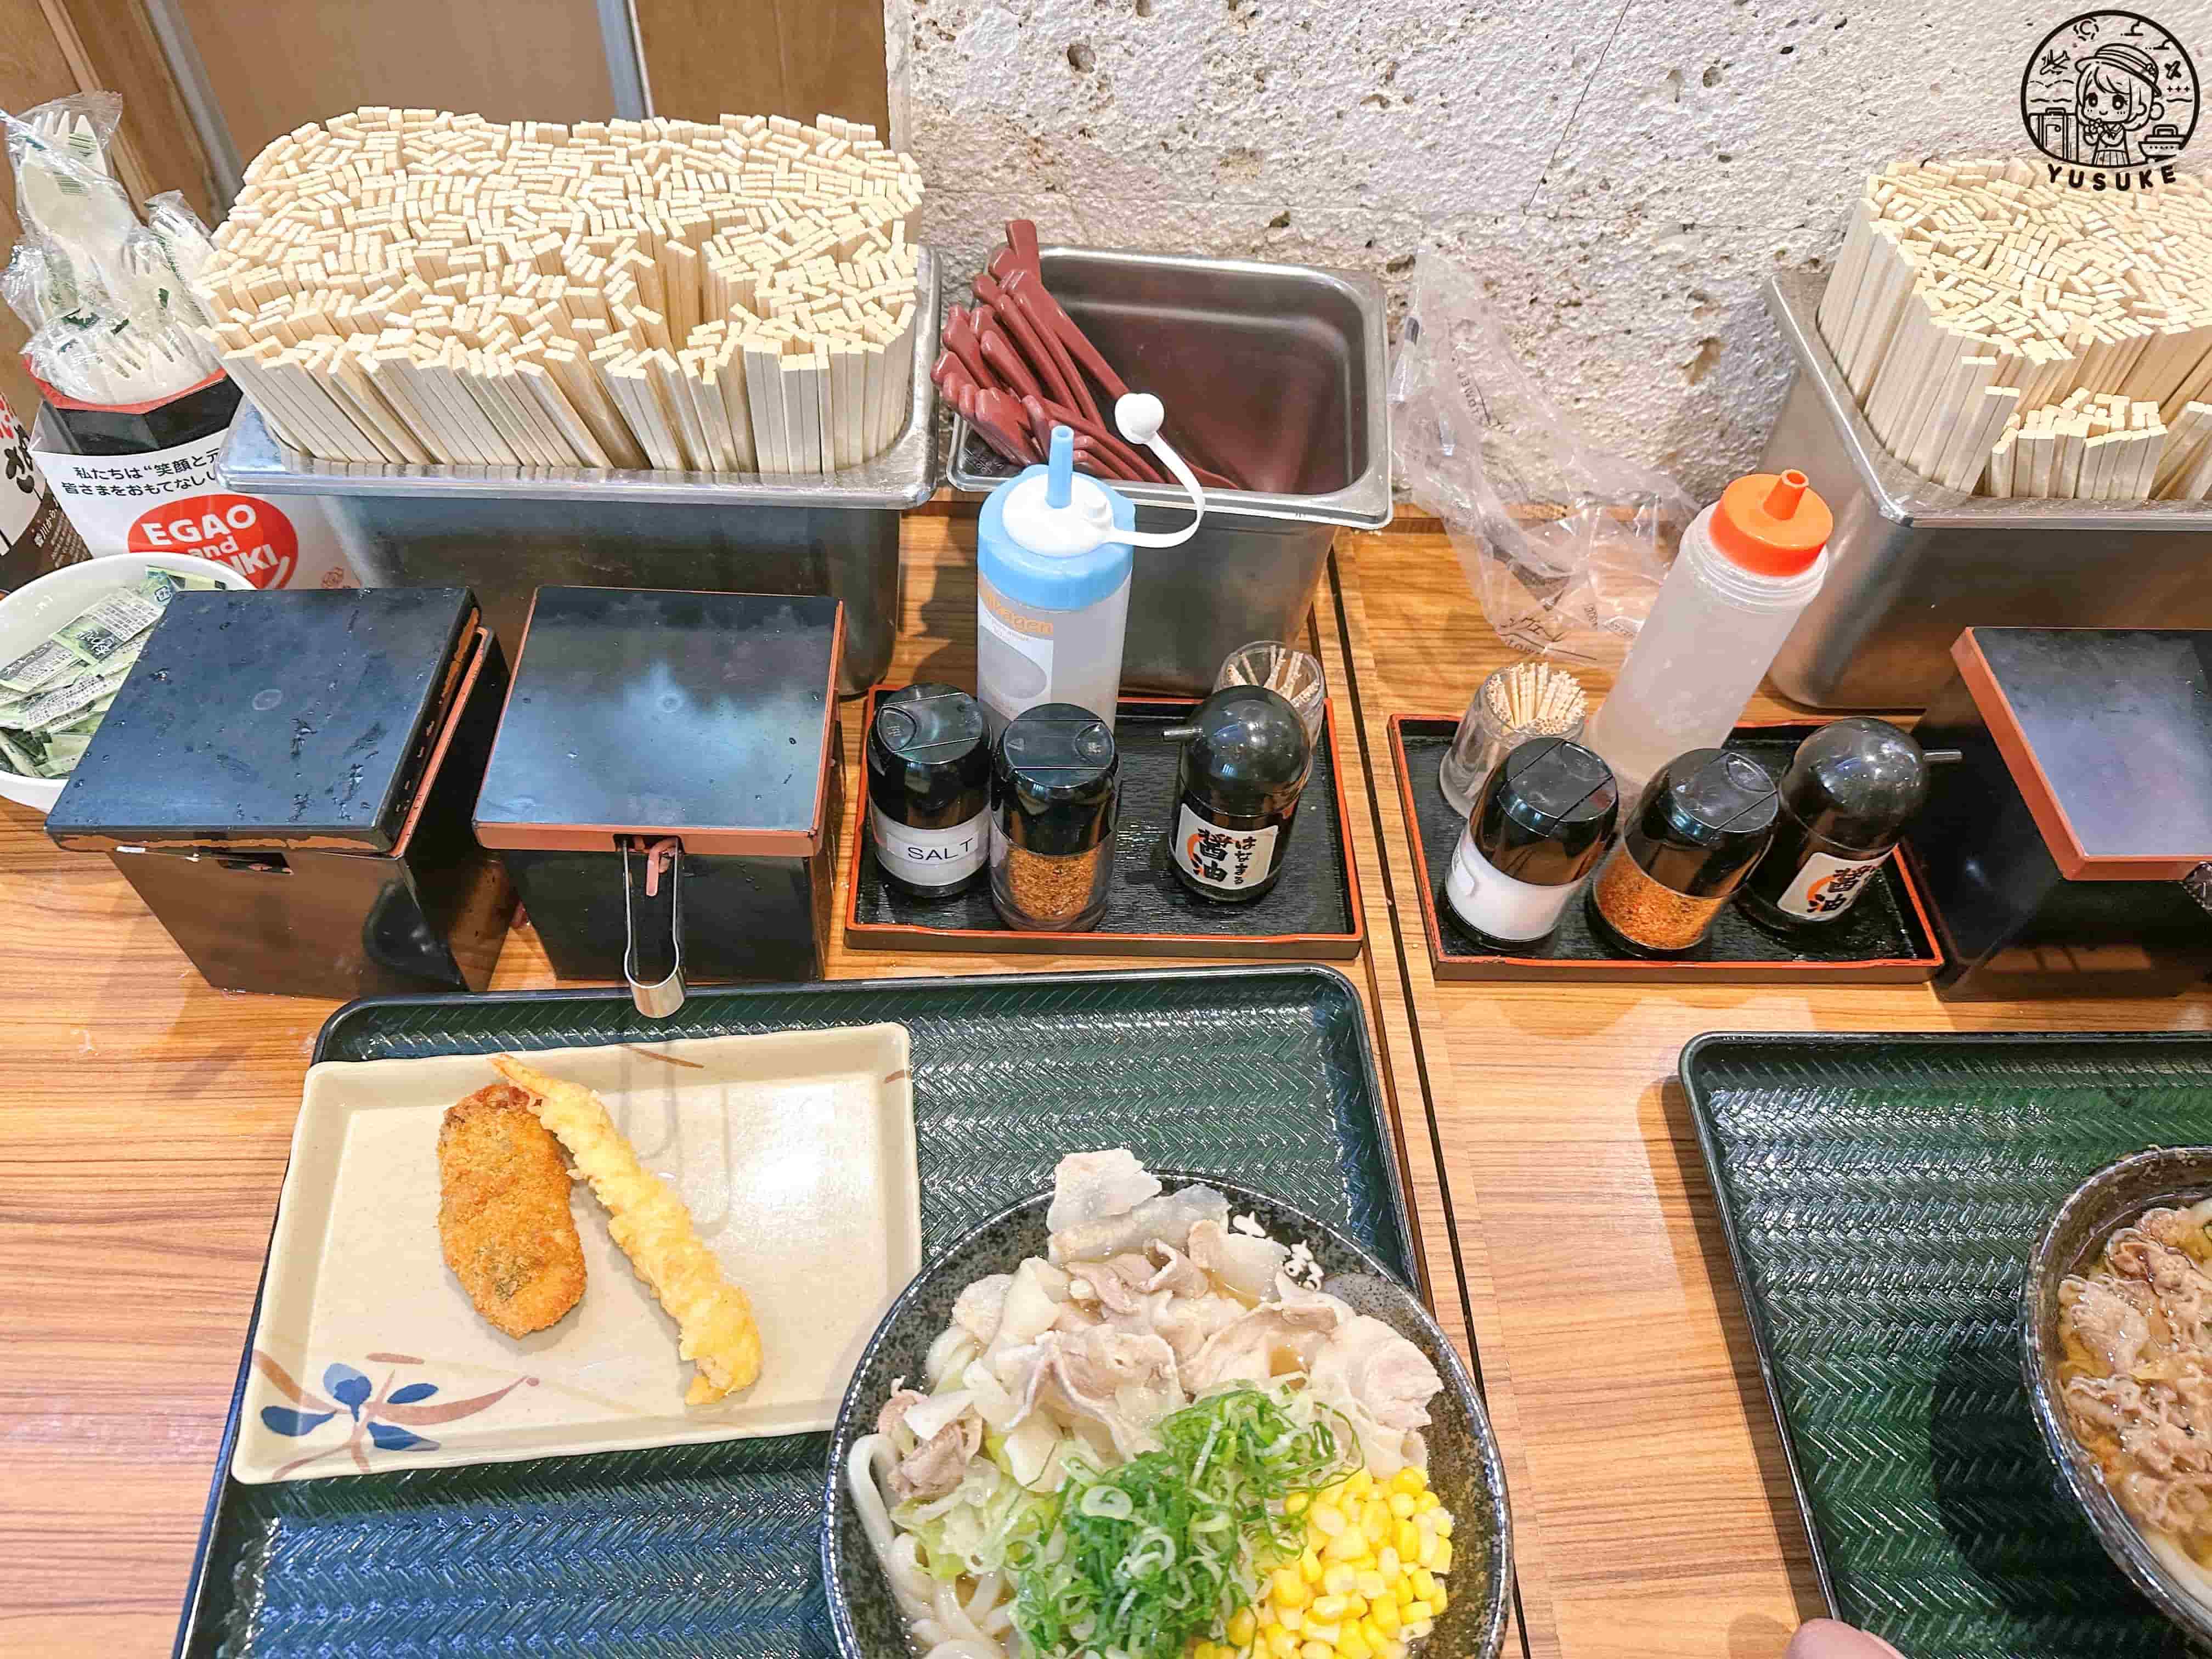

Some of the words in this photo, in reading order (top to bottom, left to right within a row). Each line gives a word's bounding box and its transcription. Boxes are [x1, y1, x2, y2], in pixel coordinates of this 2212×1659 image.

[141, 504, 257, 546] EGAO
[188, 535, 239, 558] and
[216, 544, 279, 577] NKI
[907, 837, 973, 861] SALT
[1193, 827, 1234, 883] 醤油
